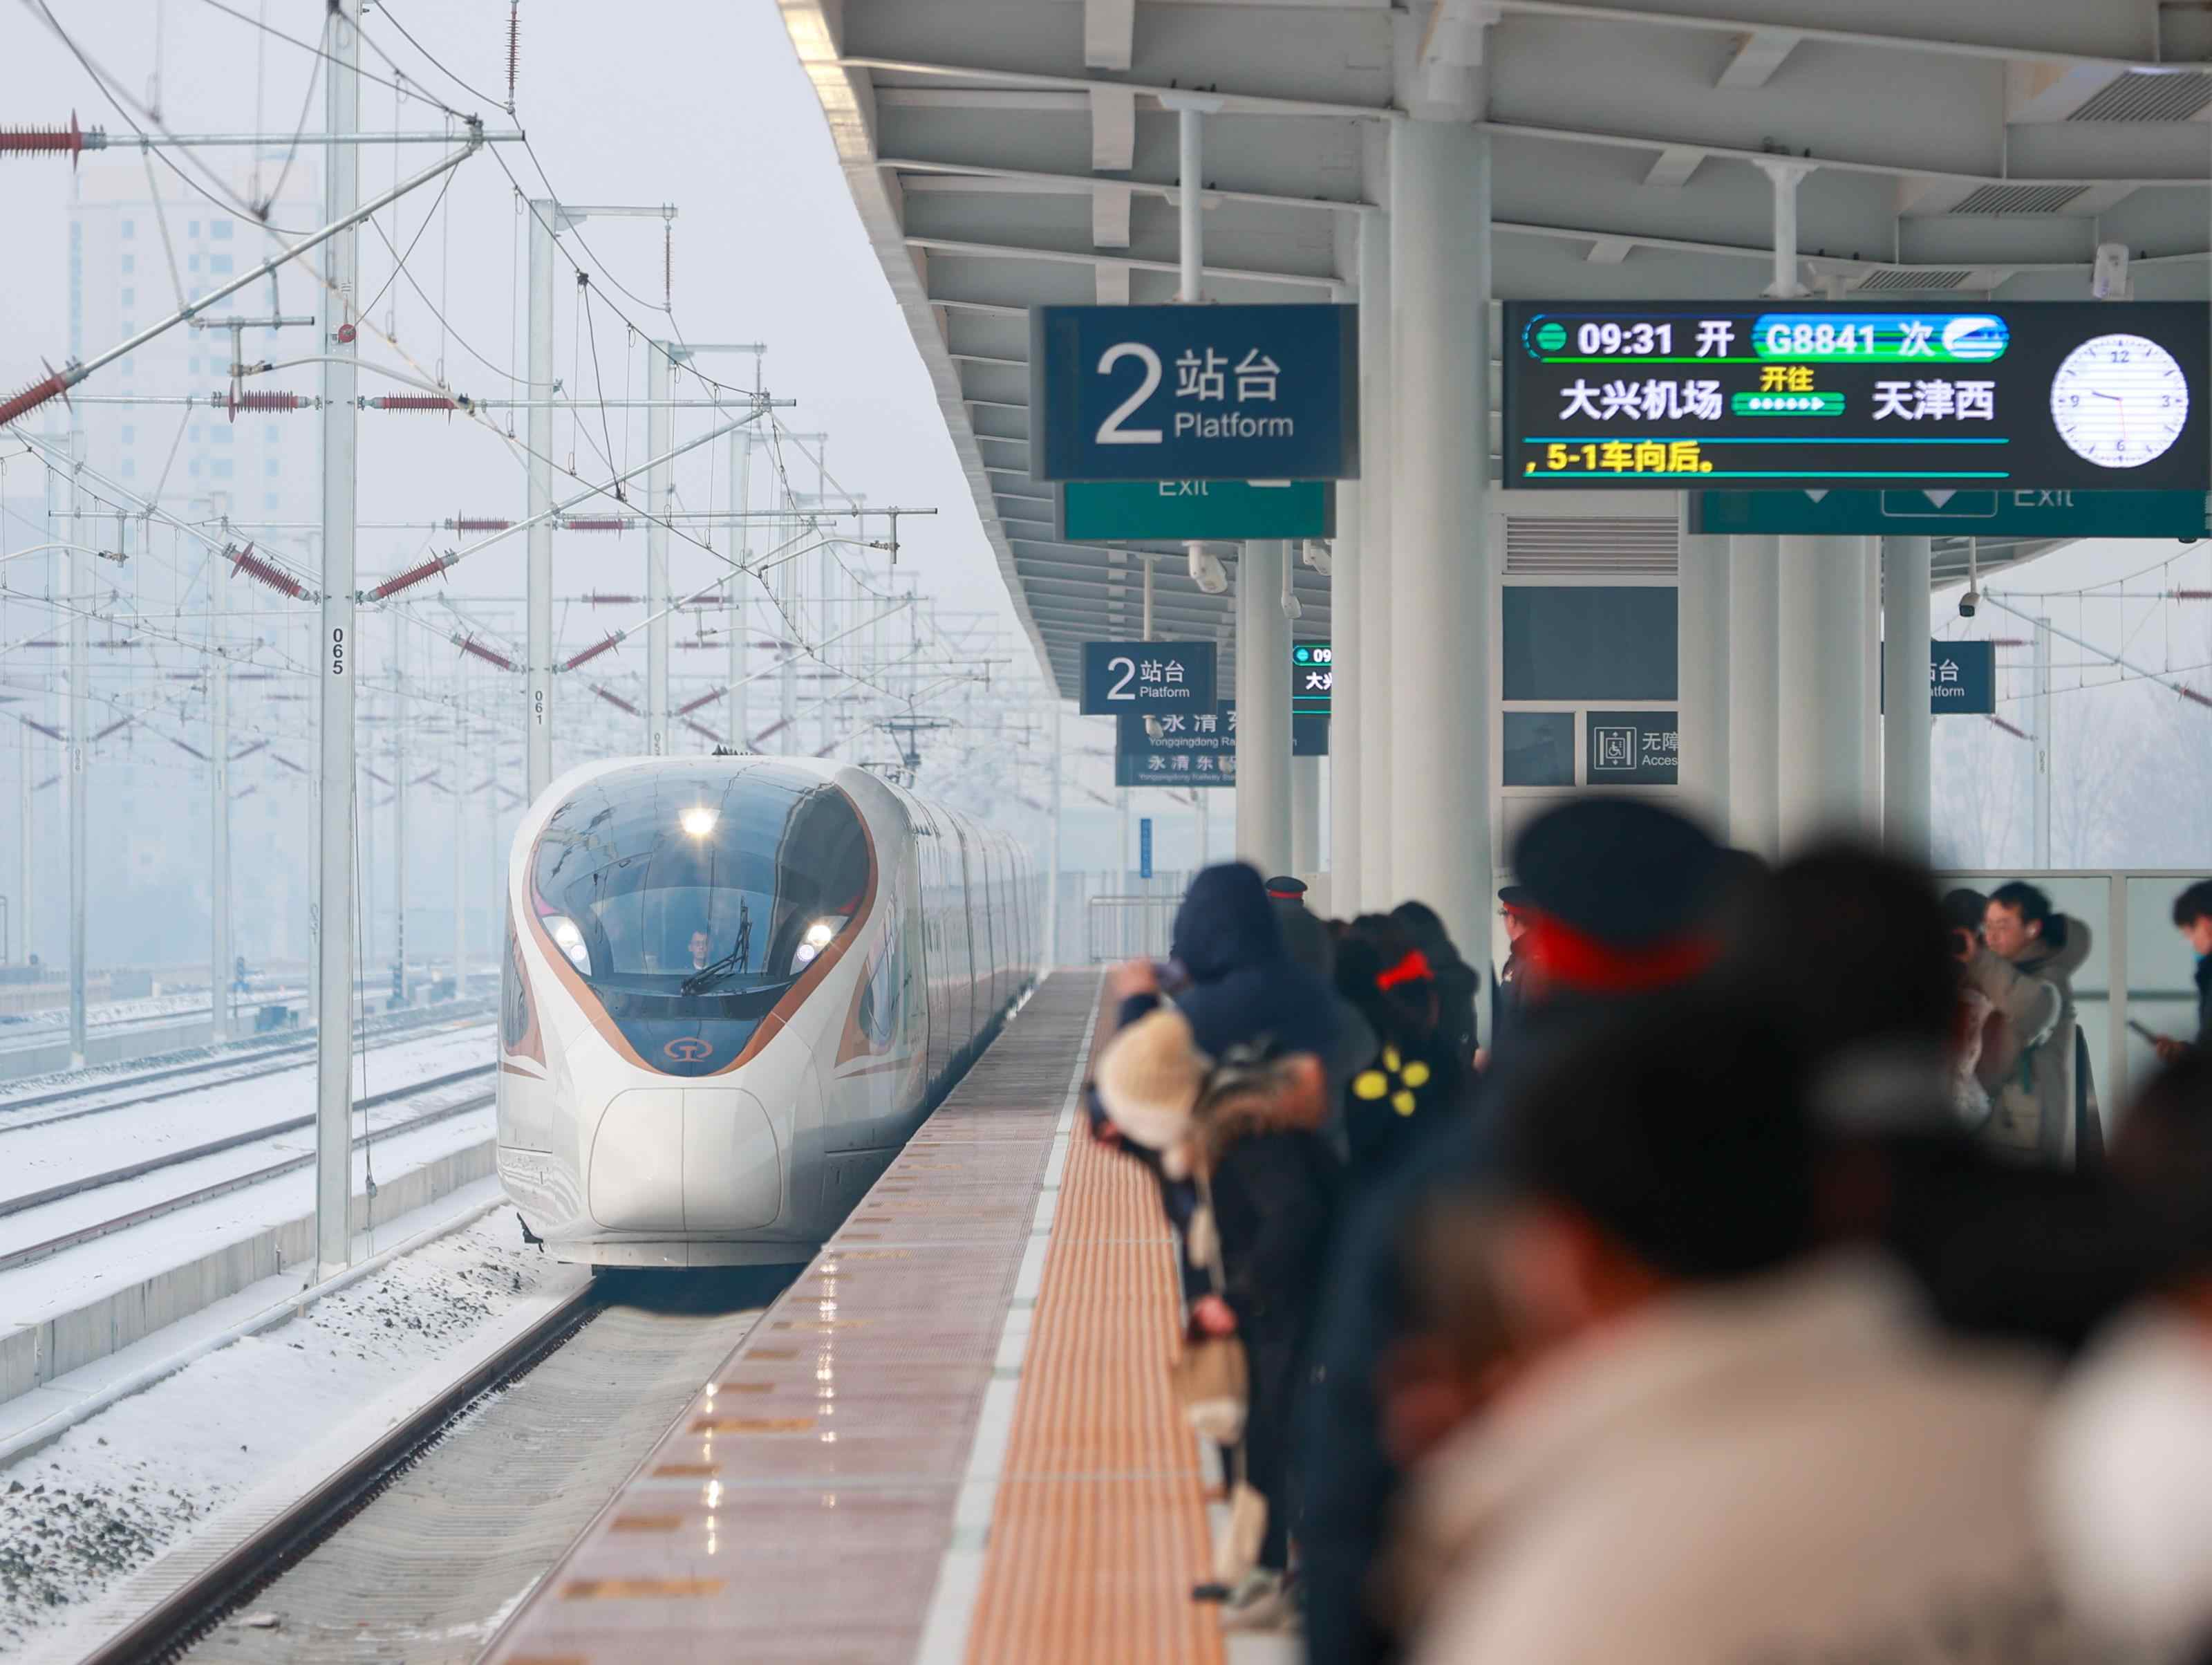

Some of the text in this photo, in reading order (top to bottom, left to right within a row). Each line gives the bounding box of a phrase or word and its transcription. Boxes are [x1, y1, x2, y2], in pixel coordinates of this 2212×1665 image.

[1578, 320, 1936, 357] 09:31 开 G8841 次
[2110, 350, 2130, 364] 12
[1175, 347, 1282, 402] 站台
[1759, 365, 1815, 393] 开往
[1095, 342, 1163, 445] 2
[1559, 378, 1996, 421] 大兴机场 天津西
[2070, 395, 2080, 407] 9
[2162, 395, 2171, 407] 3
[1174, 411, 1294, 438] Platform
[2117, 440, 2126, 452] 6
[332, 628, 344, 675] 065
[1107, 656, 1136, 700] 2
[1140, 659, 1185, 683] 站台
[1140, 686, 1190, 698] Platform
[534, 691, 543, 725] 061
[1149, 755, 1236, 771] 永清东
